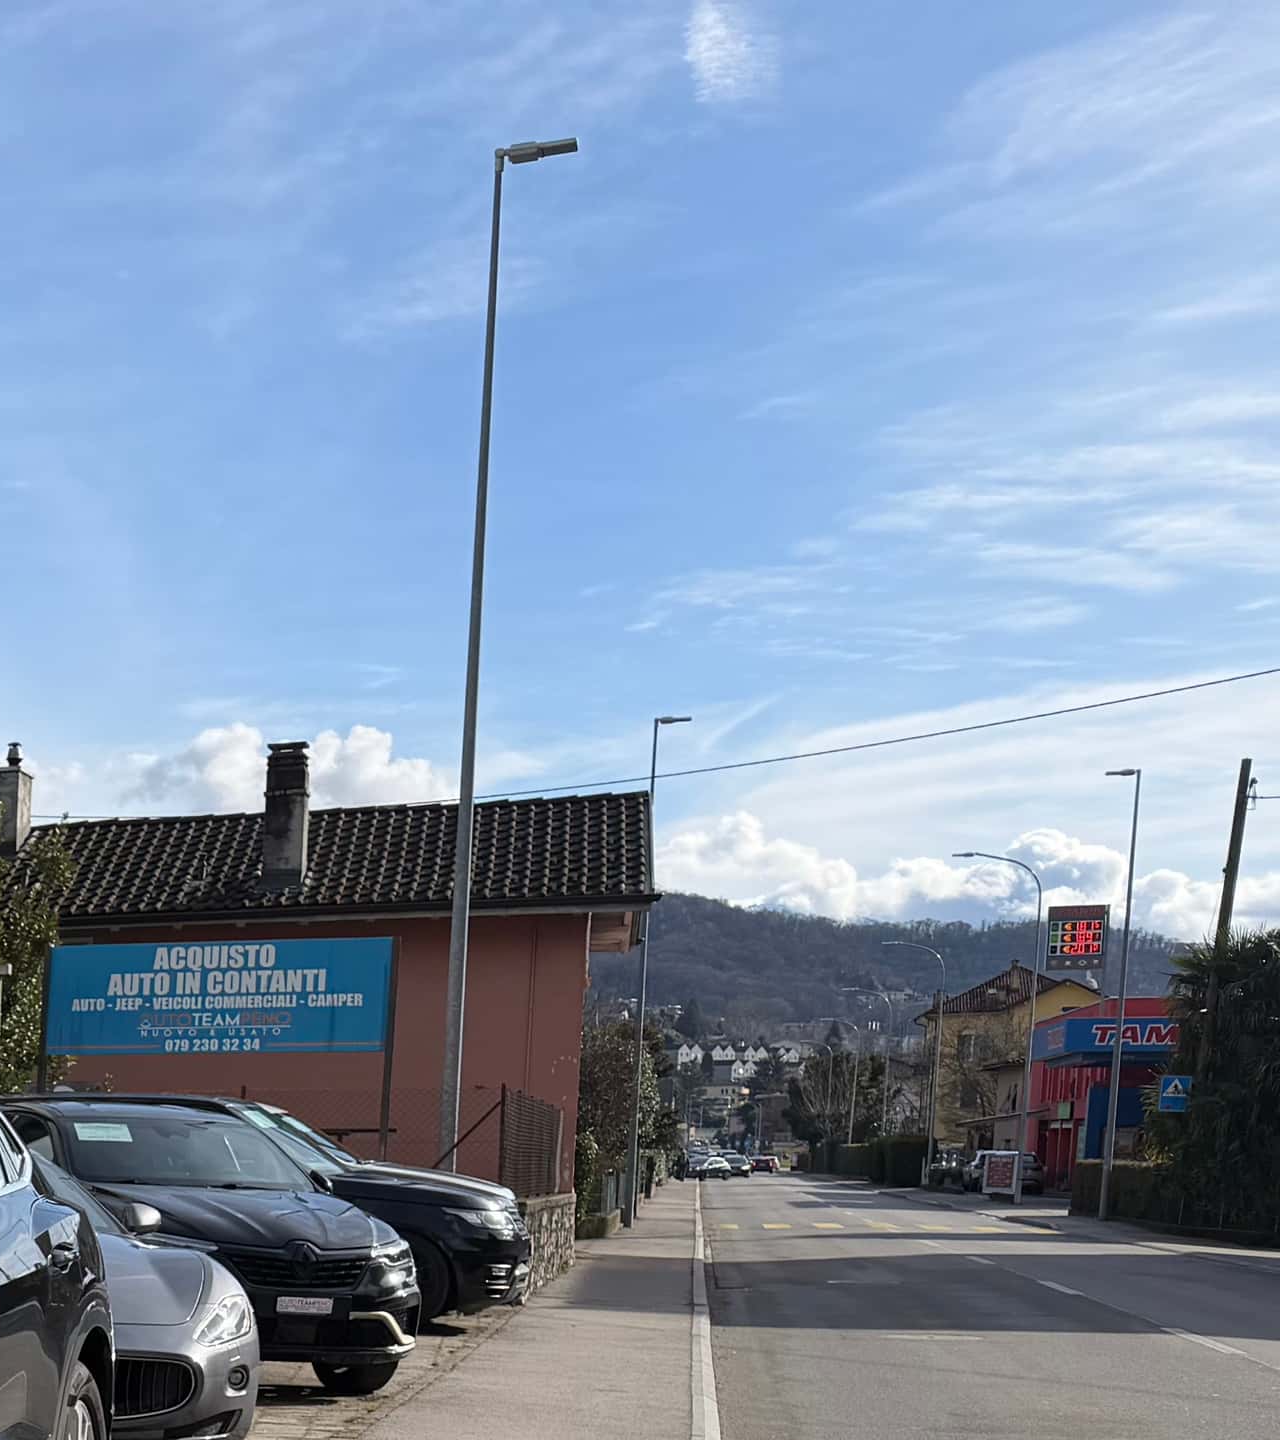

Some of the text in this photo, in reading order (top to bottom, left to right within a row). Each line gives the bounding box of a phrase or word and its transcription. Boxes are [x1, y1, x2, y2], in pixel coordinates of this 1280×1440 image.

[153, 943, 276, 971] ACQUISTO
[107, 968, 327, 996] AUTO IN CONTANTI
[72, 998, 105, 1012] AUTO
[115, 998, 142, 1011] JEEP
[152, 997, 202, 1010] VEICOLI
[205, 995, 297, 1010] COMMERCIALI
[307, 993, 363, 1008] CAMPER
[165, 1037, 260, 1052] 079 230 32 34
